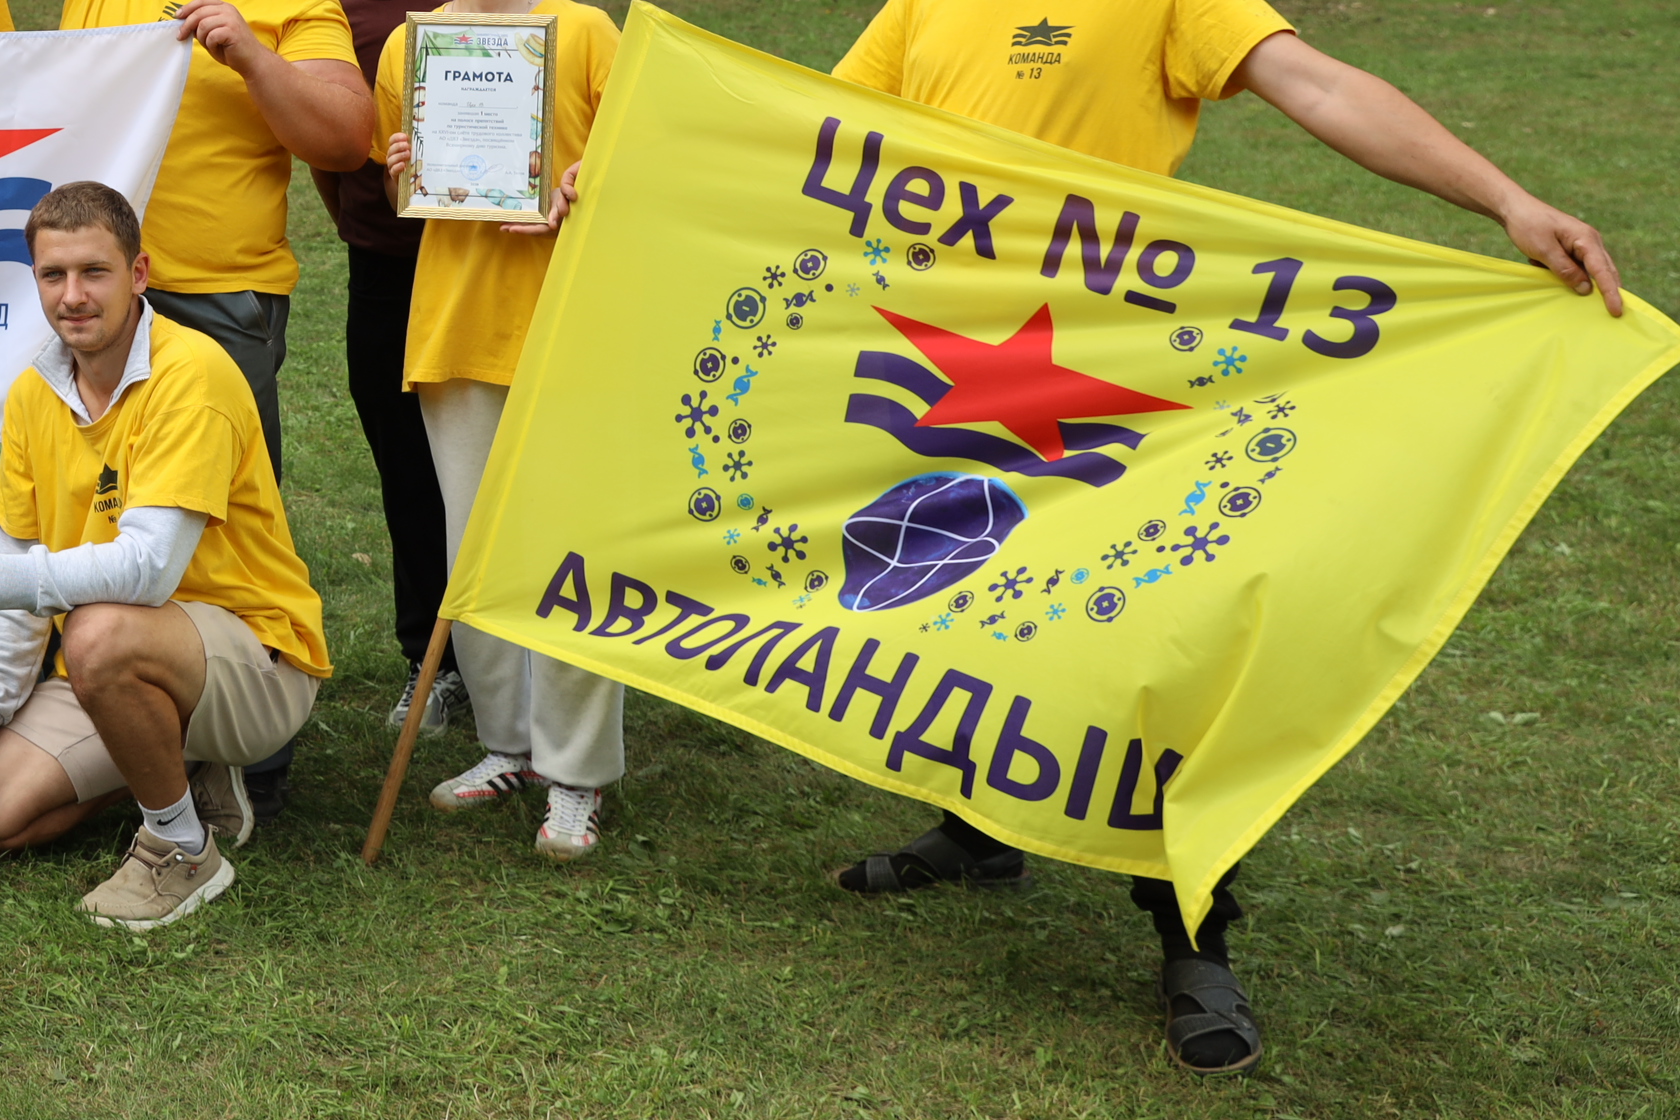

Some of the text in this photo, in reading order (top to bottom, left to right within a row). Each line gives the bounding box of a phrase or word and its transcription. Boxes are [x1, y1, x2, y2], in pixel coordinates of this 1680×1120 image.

[477, 37, 509, 46] ЗВЕЗДА
[1007, 52, 1062, 65] КОМАНДА
[444, 70, 514, 83] ГРАМОТА
[1015, 67, 1042, 80] № 13
[801, 116, 1398, 360] Цех № 13
